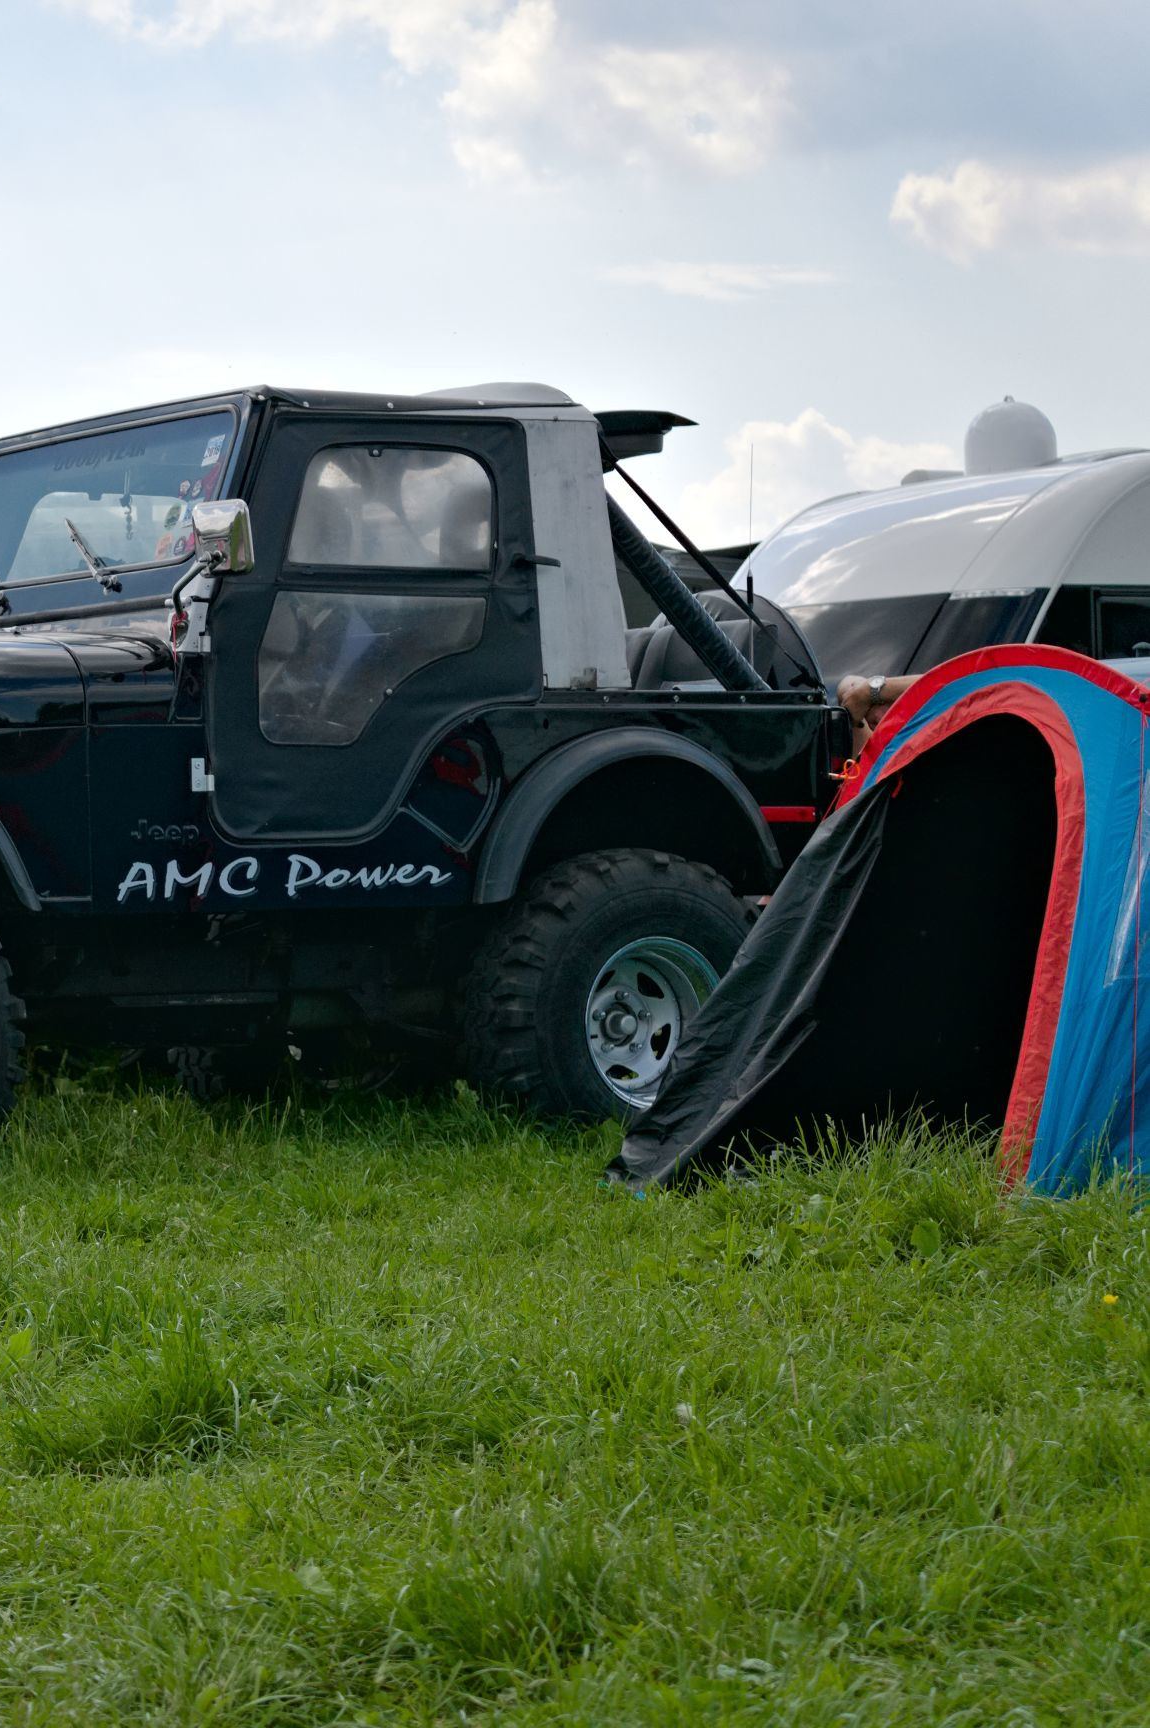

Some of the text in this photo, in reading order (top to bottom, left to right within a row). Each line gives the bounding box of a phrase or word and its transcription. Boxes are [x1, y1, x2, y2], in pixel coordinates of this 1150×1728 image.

[130, 818, 200, 846] Jeep
[116, 853, 454, 902] AMC Power
